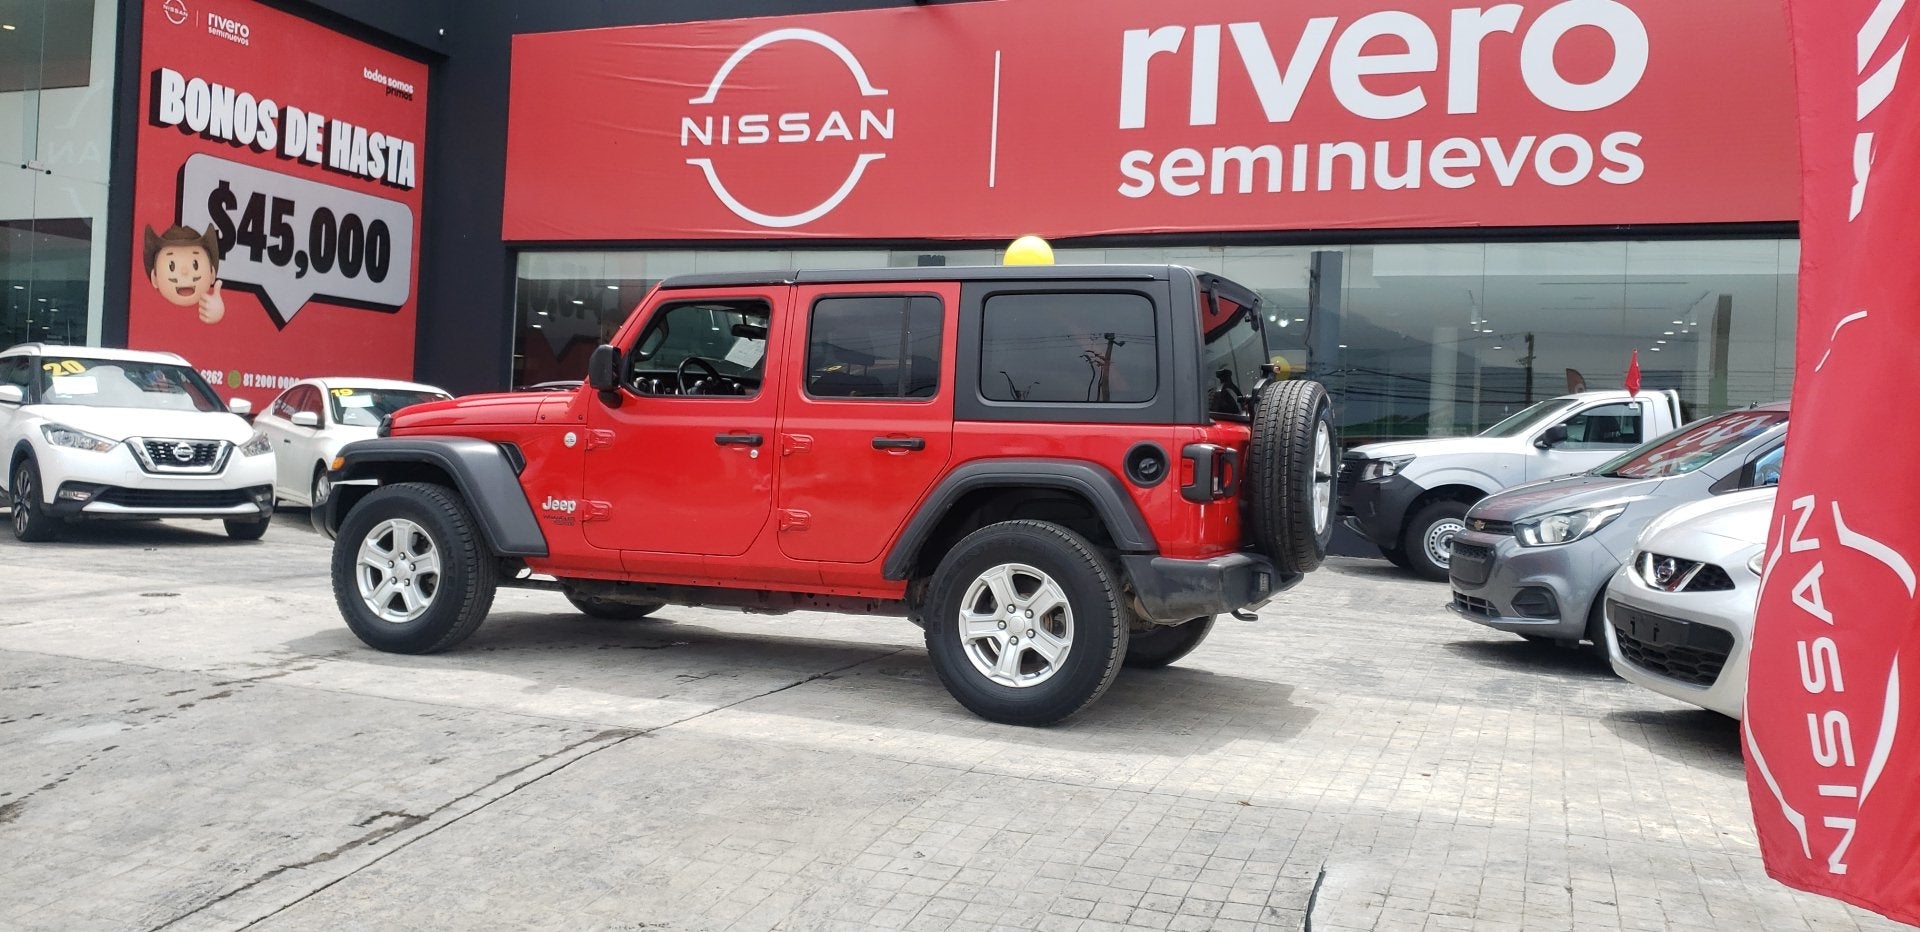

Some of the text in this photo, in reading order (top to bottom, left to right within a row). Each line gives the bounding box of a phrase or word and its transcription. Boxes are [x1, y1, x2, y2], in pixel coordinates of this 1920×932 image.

[207, 12, 250, 38] rivero
[207, 26, 249, 46] seminuevos
[1119, 0, 1650, 129] rivero
[363, 66, 414, 94] todos somos
[385, 86, 413, 102] primos
[157, 67, 416, 189] BONOS DE HASTA
[680, 108, 895, 146] NISSAN
[1118, 131, 1645, 198] seminuevos
[207, 179, 392, 284] $45,000
[42, 360, 87, 376] 20
[243, 373, 253, 386] 81
[255, 375, 276, 389] 2001
[330, 388, 353, 397] 19
[541, 495, 577, 514] Jeep
[1790, 494, 1859, 875] NISSAN
